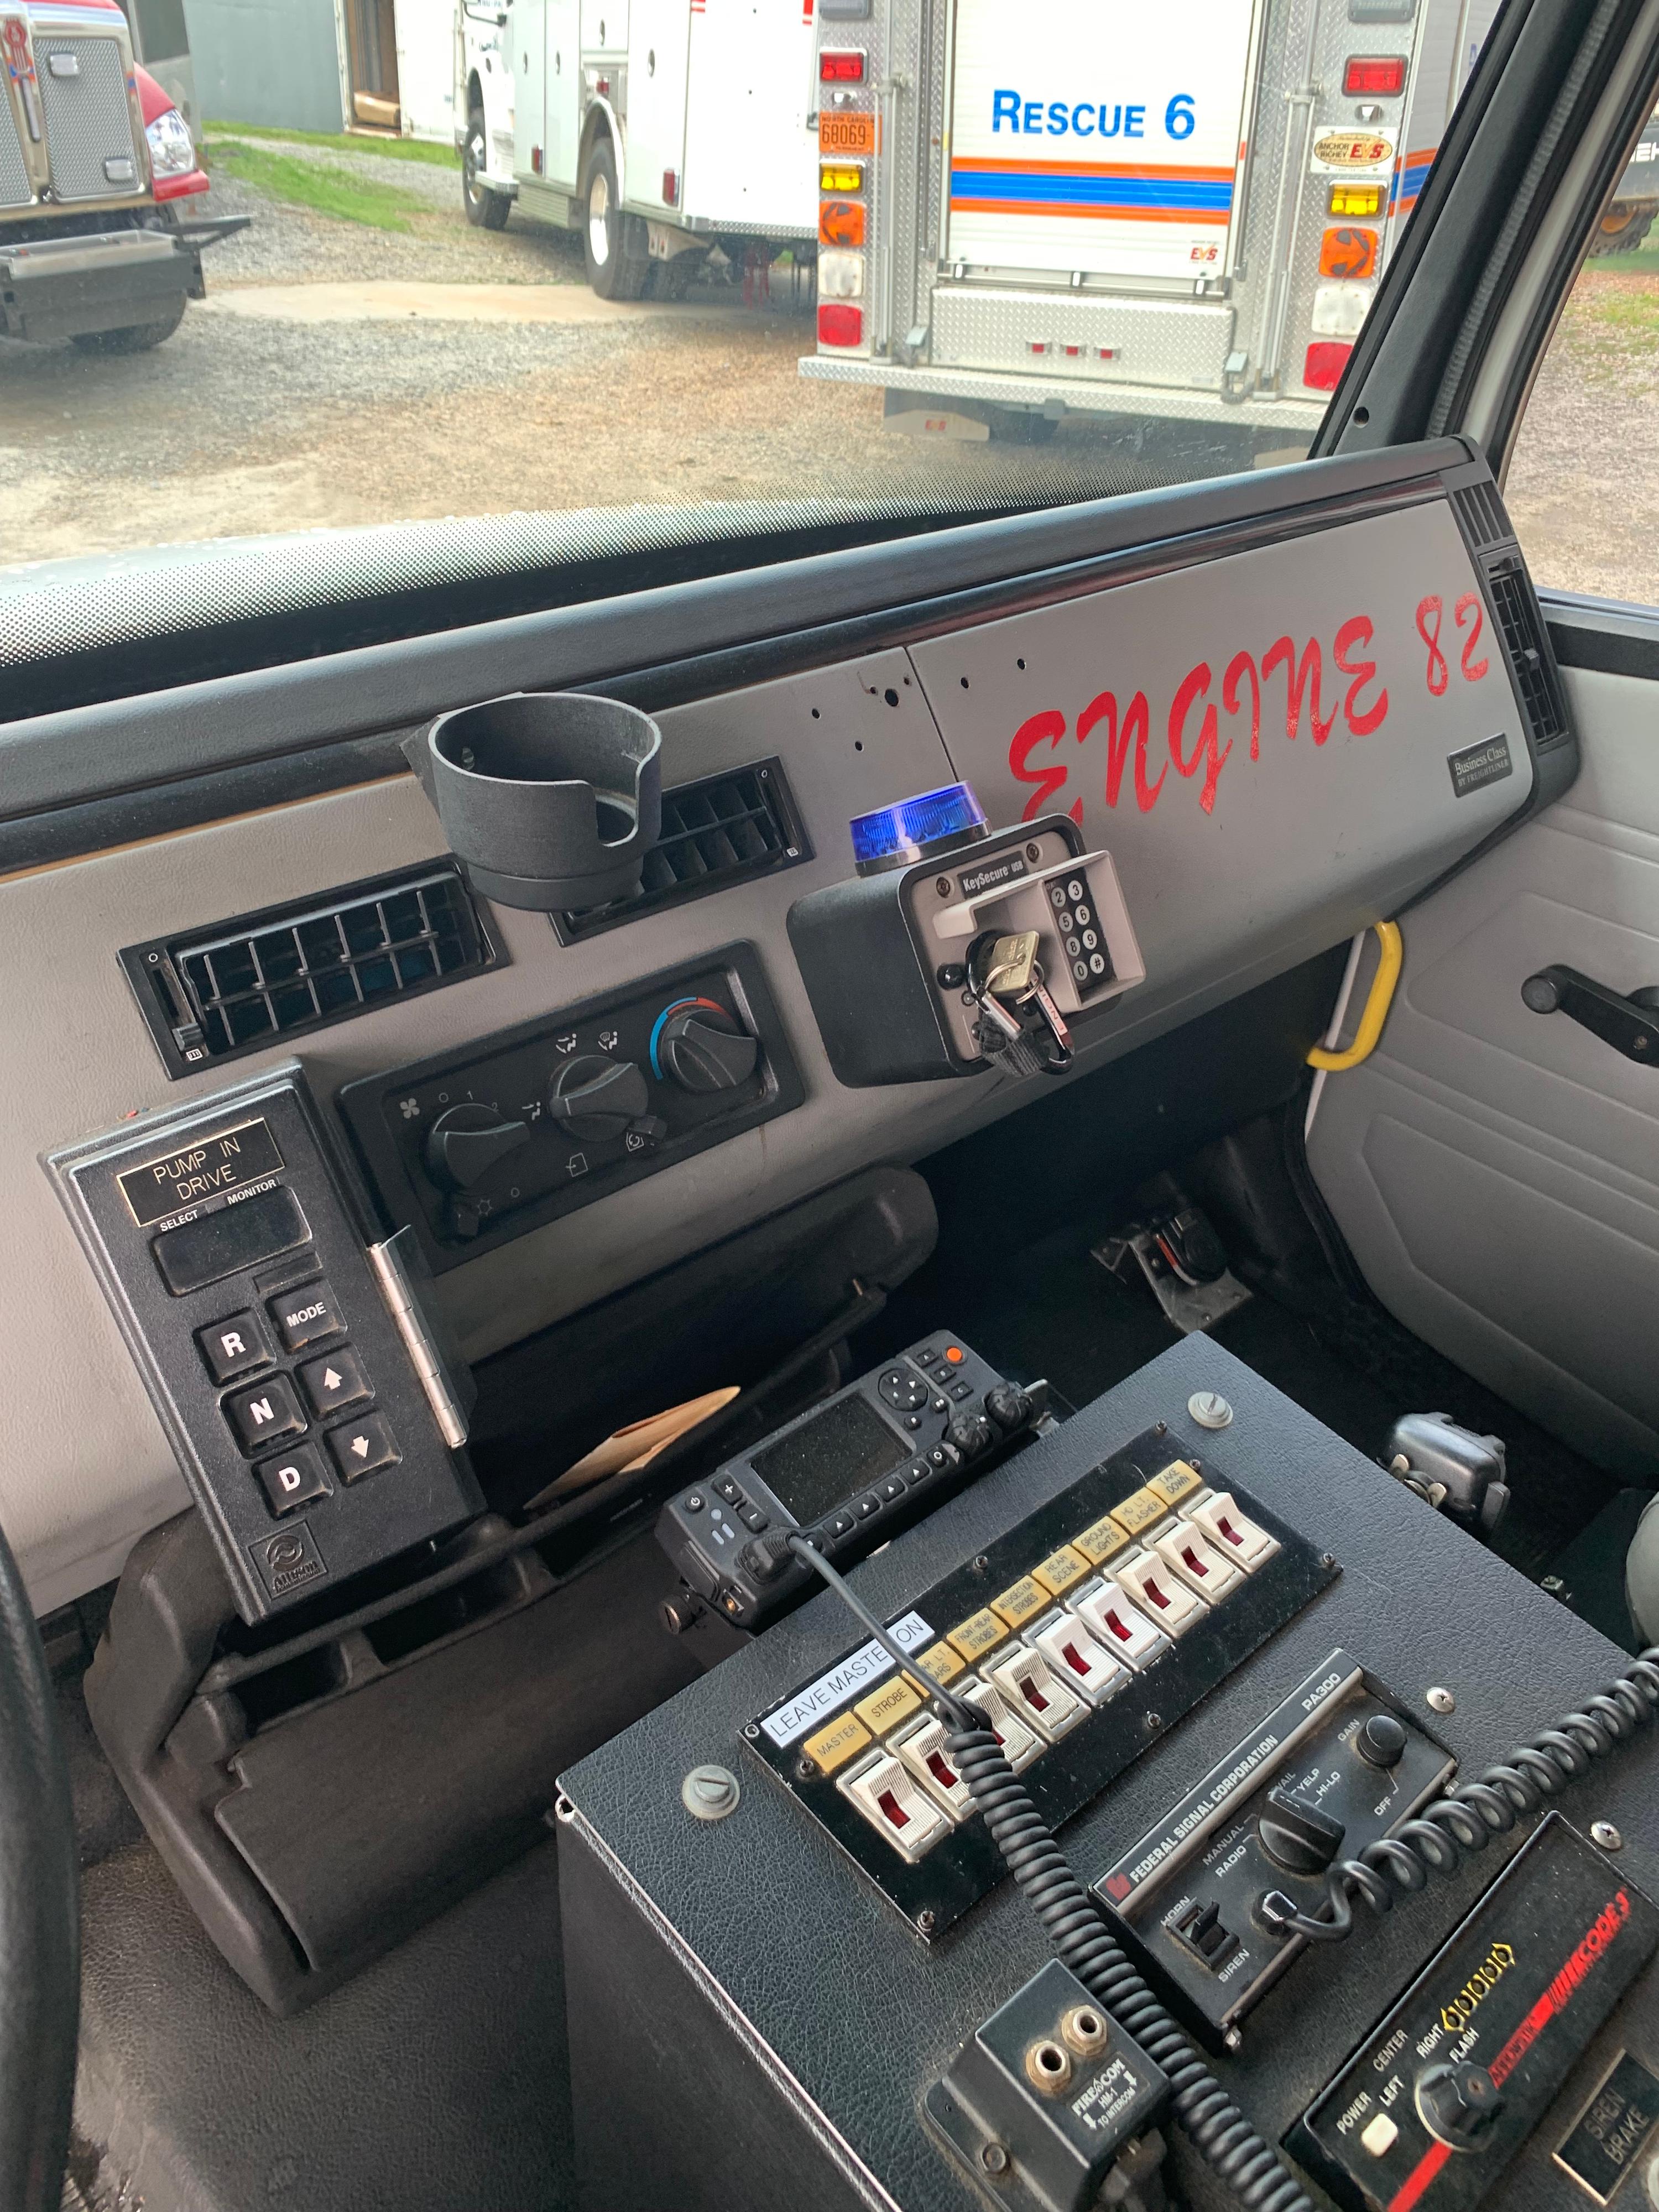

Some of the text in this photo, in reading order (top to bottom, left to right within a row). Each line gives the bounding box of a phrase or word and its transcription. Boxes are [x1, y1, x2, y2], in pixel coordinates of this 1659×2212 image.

[1165, 93, 1195, 140] 6
[1319, 142, 1349, 150] ANCHOR
[1350, 138, 1385, 158] EVS
[1008, 592, 1489, 827] ENGINE 82
[1454, 747, 1506, 775] Business Class
[1467, 758, 1509, 784] FREIGHTLINER
[1011, 860, 1024, 873] USB
[1055, 884, 1079, 903] 2 3
[1063, 909, 1087, 927] 5 6
[1070, 934, 1094, 952] 8 9
[1078, 965, 1084, 976] 0
[153, 1137, 241, 1185] PUMP IN
[176, 1164, 237, 1200] DRIVE
[160, 1178, 276, 1232] SELECT MONITOR
[286, 1302, 327, 1327] MODE
[221, 1331, 246, 1357] R
[250, 1397, 274, 1425] N
[278, 1467, 301, 1491] D
[1157, 1468, 1180, 1485] TAKE
[1166, 1474, 1191, 1494] DOWN
[1126, 1500, 1161, 1527] FLASHER
[1081, 1522, 1112, 1546] GROUND
[1090, 1531, 1120, 1555] LIGHTS
[1045, 1554, 1068, 1573] REAR
[1052, 1560, 1080, 1583] SCENE
[998, 1580, 1035, 1610] INTERSECTION
[1012, 1593, 1039, 1615] STROBES
[954, 1613, 993, 1643] FRONT-REAR
[968, 1625, 998, 1650] STROBES
[770, 1619, 924, 1737] LEAVE MASTE ON
[1301, 1673, 1341, 1711] PA300
[872, 1688, 907, 1718] STROBE
[817, 1724, 859, 1757] MASTER
[1337, 1719, 1360, 1741] GAIN
[1297, 1768, 1320, 1791] YELP
[1316, 1771, 1340, 1796] HI-LO
[1130, 1734, 1279, 1882] FEDERAL SIGNAL CORPORATION
[1374, 1796, 1392, 1817] OFF
[1202, 1825, 1244, 1866] MANUAL
[1215, 1845, 1246, 1877] RADIO
[1160, 1895, 1190, 1926] HORN
[1578, 1901, 1621, 1964] CODE
[1218, 1948, 1250, 1983] SIREN
[1373, 2029, 1408, 2072] CENTER
[1416, 2023, 1444, 2058] RIGHT
[1449, 2027, 1480, 2064] FLASH
[1098, 2086, 1118, 2110] HM-1
[1379, 2075, 1405, 2107] LEFT
[1097, 2086, 1136, 2128] TO INTERCOM
[1336, 2091, 1373, 2135] POWER
[1586, 2088, 1626, 2142] SIREN
[1600, 2104, 1650, 2166] BRAKE
